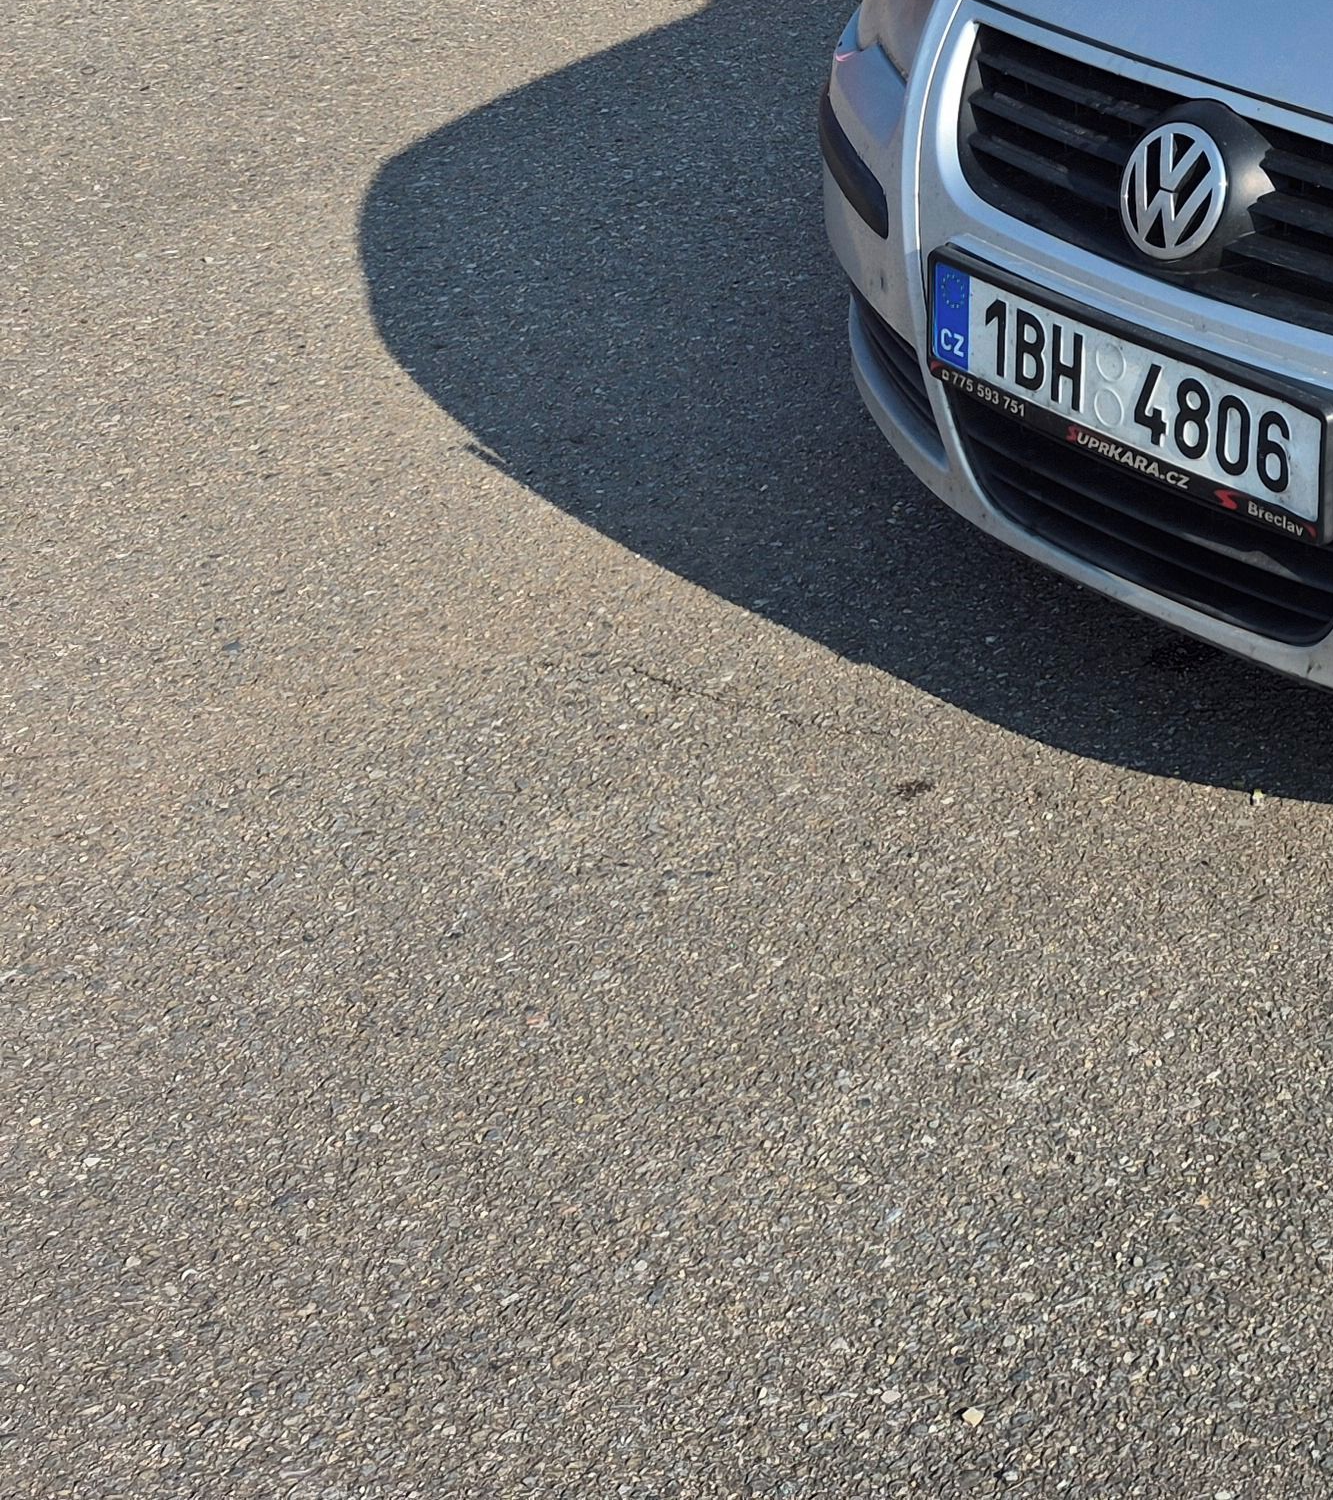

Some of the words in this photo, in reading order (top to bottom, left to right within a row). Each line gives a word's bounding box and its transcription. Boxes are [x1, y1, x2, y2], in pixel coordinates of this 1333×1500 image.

[940, 328, 965, 358] CZ
[951, 371, 973, 392] 775
[977, 383, 999, 405] 593
[1003, 395, 1025, 417] 751
[985, 299, 1084, 413] 1BH
[1134, 363, 1290, 493] 4806
